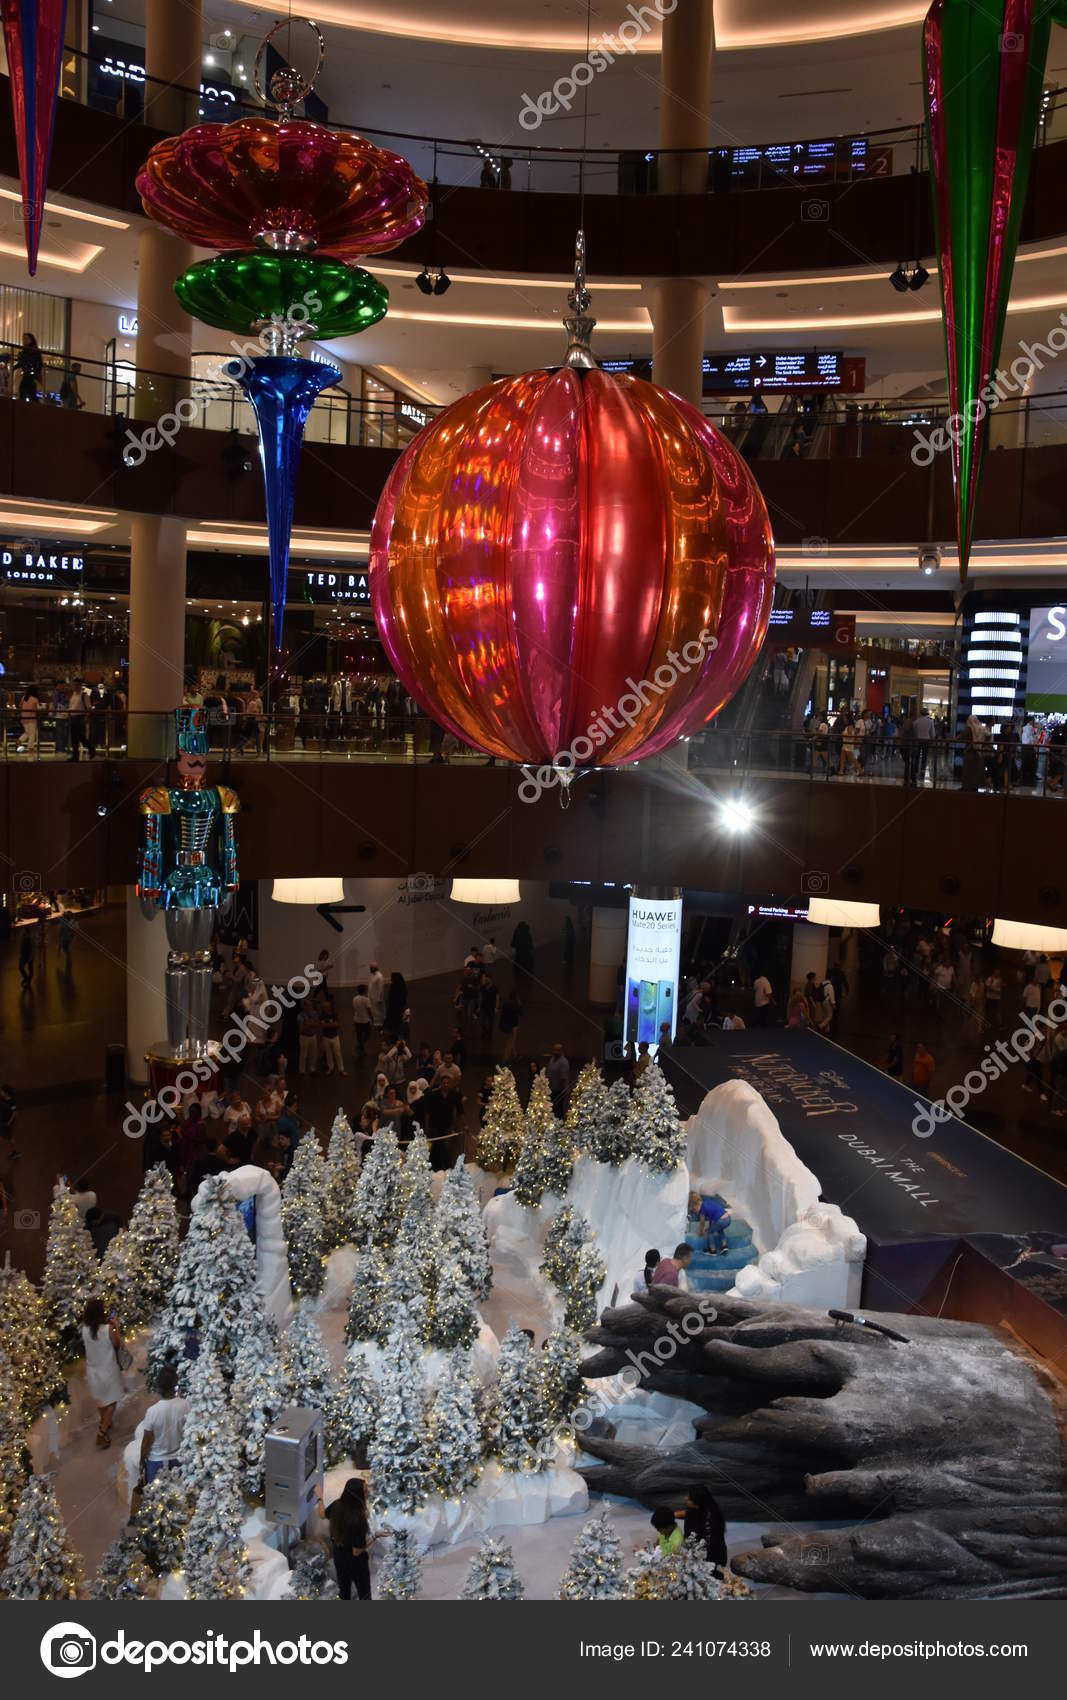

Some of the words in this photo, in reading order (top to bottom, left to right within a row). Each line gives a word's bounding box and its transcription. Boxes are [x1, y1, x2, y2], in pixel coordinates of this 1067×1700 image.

[793, 165, 800, 173] P
[876, 158, 888, 174] 2
[754, 378, 761, 387] P
[25, 554, 83, 570] BAKER
[7, 571, 53, 580] LONDON
[307, 573, 336, 586] TED
[1046, 606, 1066, 640] S
[835, 627, 849, 643] G
[632, 909, 677, 921] HUAWEI
[748, 905, 755, 914] P
[838, 1134, 895, 1168] DUBAI
[884, 1171, 939, 1207] MALL
[900, 1158, 926, 1174] THE
